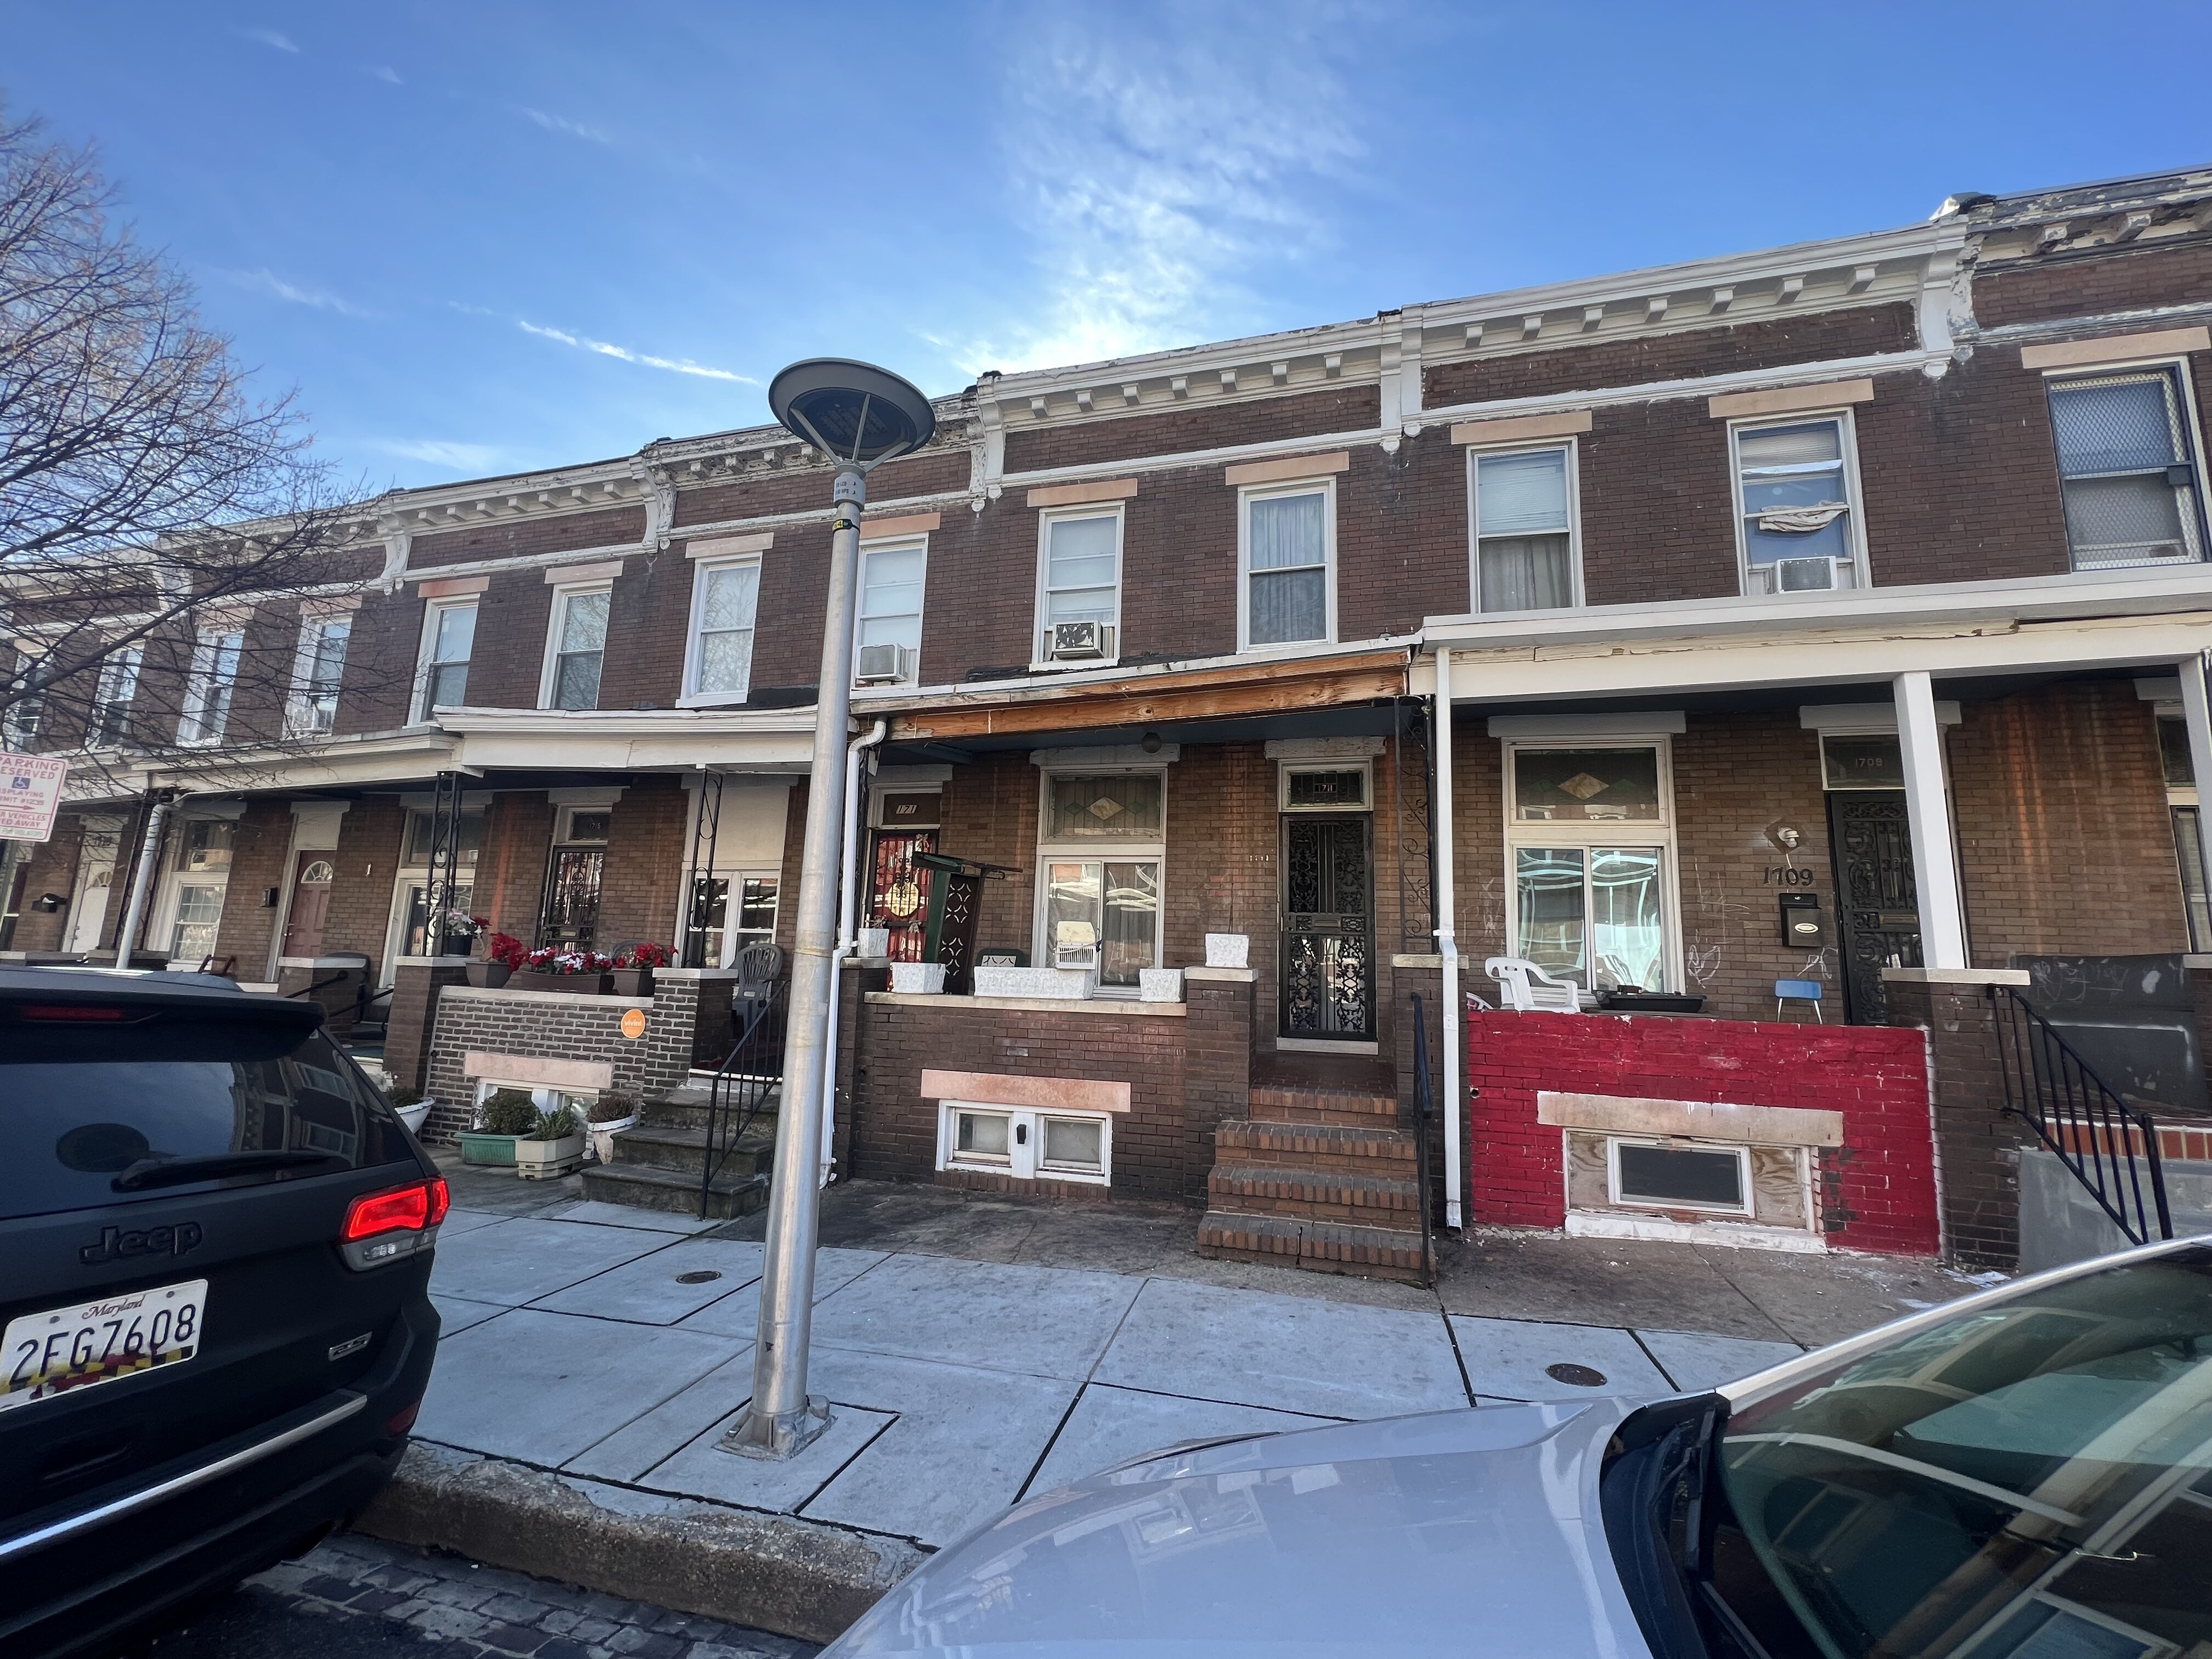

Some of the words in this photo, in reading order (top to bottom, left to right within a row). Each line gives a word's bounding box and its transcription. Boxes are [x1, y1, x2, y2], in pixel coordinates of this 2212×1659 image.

[1855, 758, 1883, 768] 1709
[0, 766, 55, 779] ESERVED
[0, 788, 44, 798] SPLAYING
[8, 811, 46, 821] VEHICLES
[1763, 866, 1814, 886] 1709
[80, 1222, 202, 1263] Jeep
[82, 1294, 146, 1319] Maryland
[8, 1304, 196, 1385] 2FG7608
